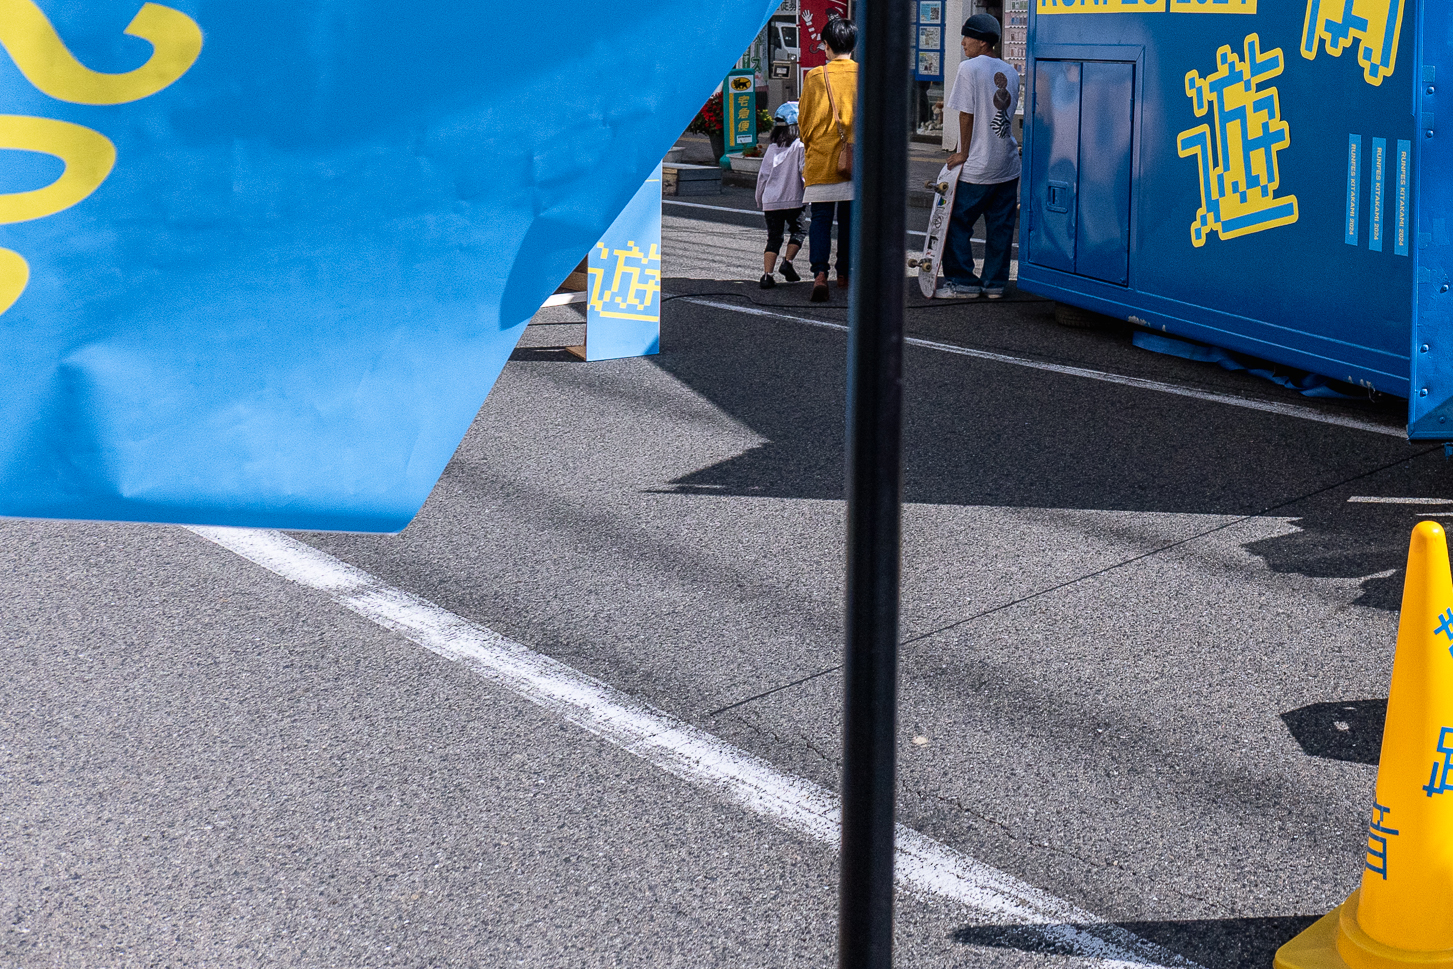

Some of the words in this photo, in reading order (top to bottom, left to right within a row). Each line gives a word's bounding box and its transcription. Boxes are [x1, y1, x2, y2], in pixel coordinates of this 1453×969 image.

[737, 95, 750, 132] 宅急便
[1375, 147, 1383, 180] RUNFES
